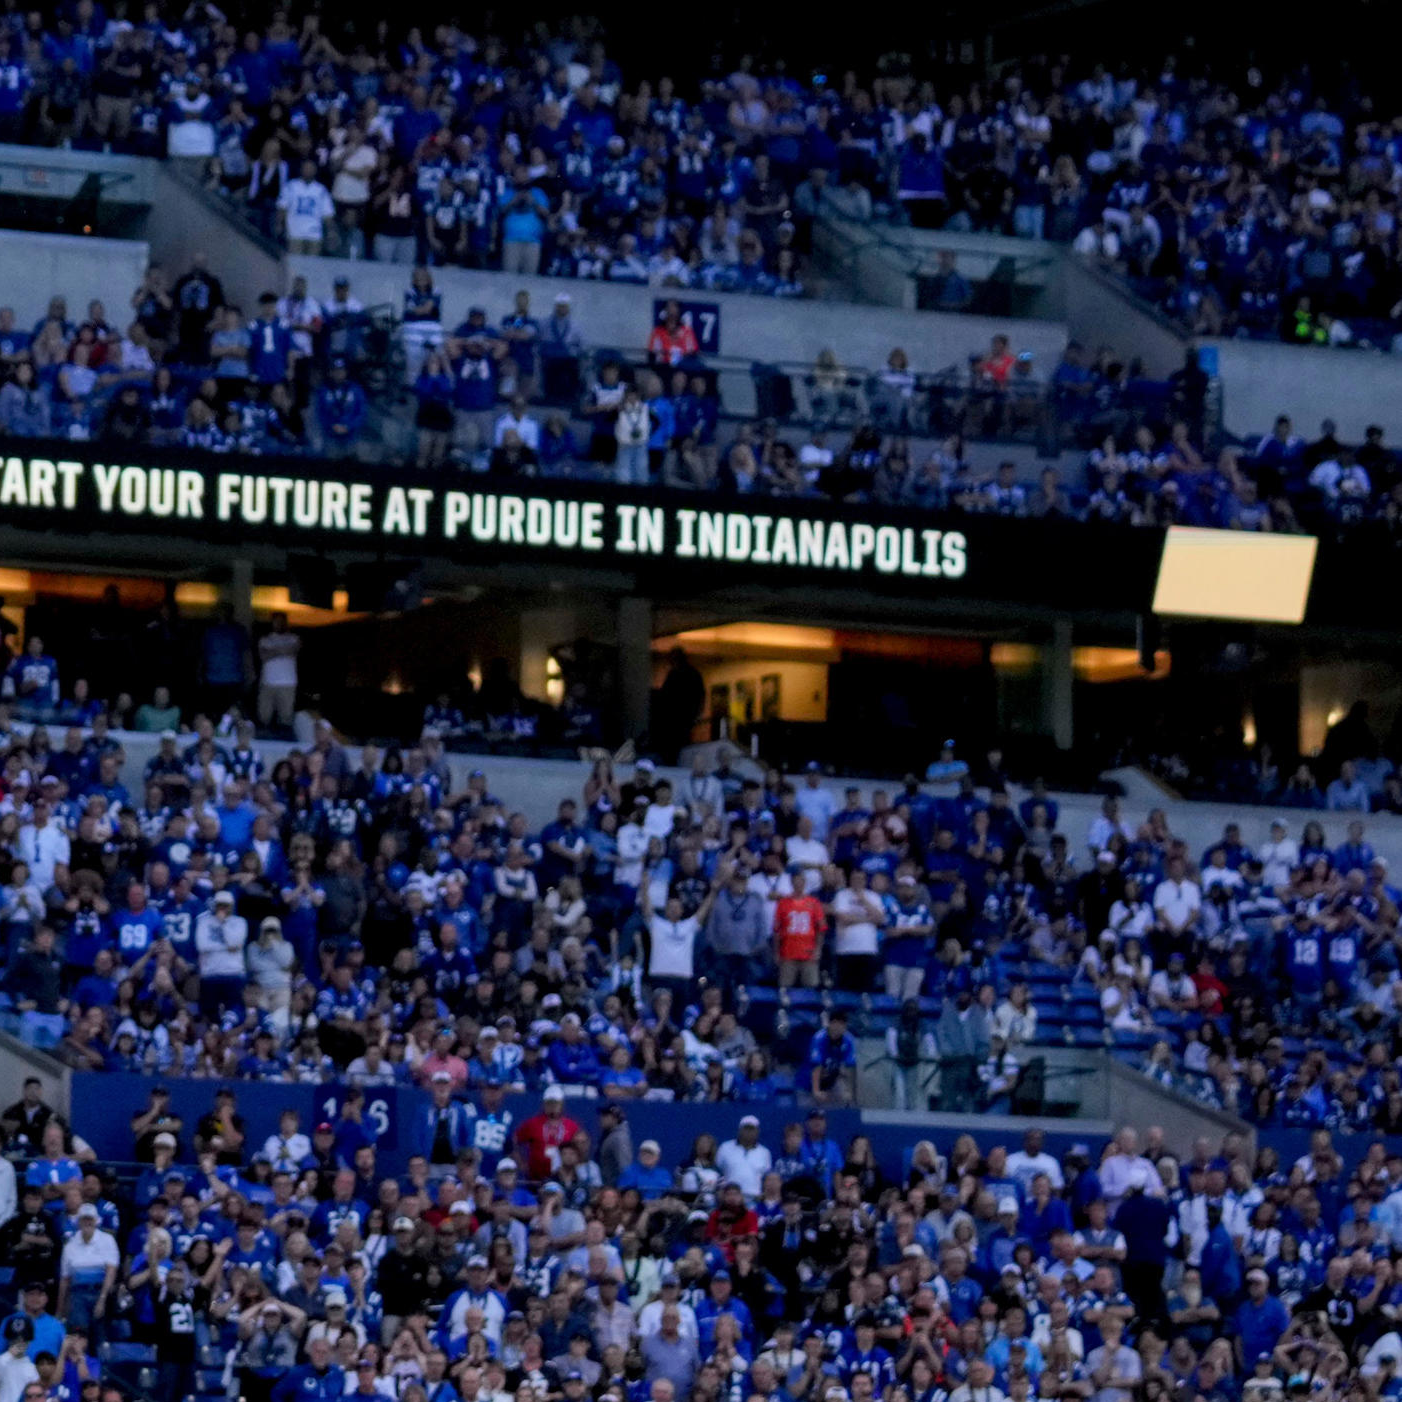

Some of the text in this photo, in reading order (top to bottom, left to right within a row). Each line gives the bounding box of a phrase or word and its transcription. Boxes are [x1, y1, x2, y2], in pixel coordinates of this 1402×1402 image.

[93, 464, 205, 518] YOUR
[218, 473, 373, 531] FUTURE
[383, 486, 434, 535] AT
[445, 491, 604, 549] PURDUE
[615, 505, 664, 554] IN
[676, 509, 966, 577] INDIANAPOLIS
